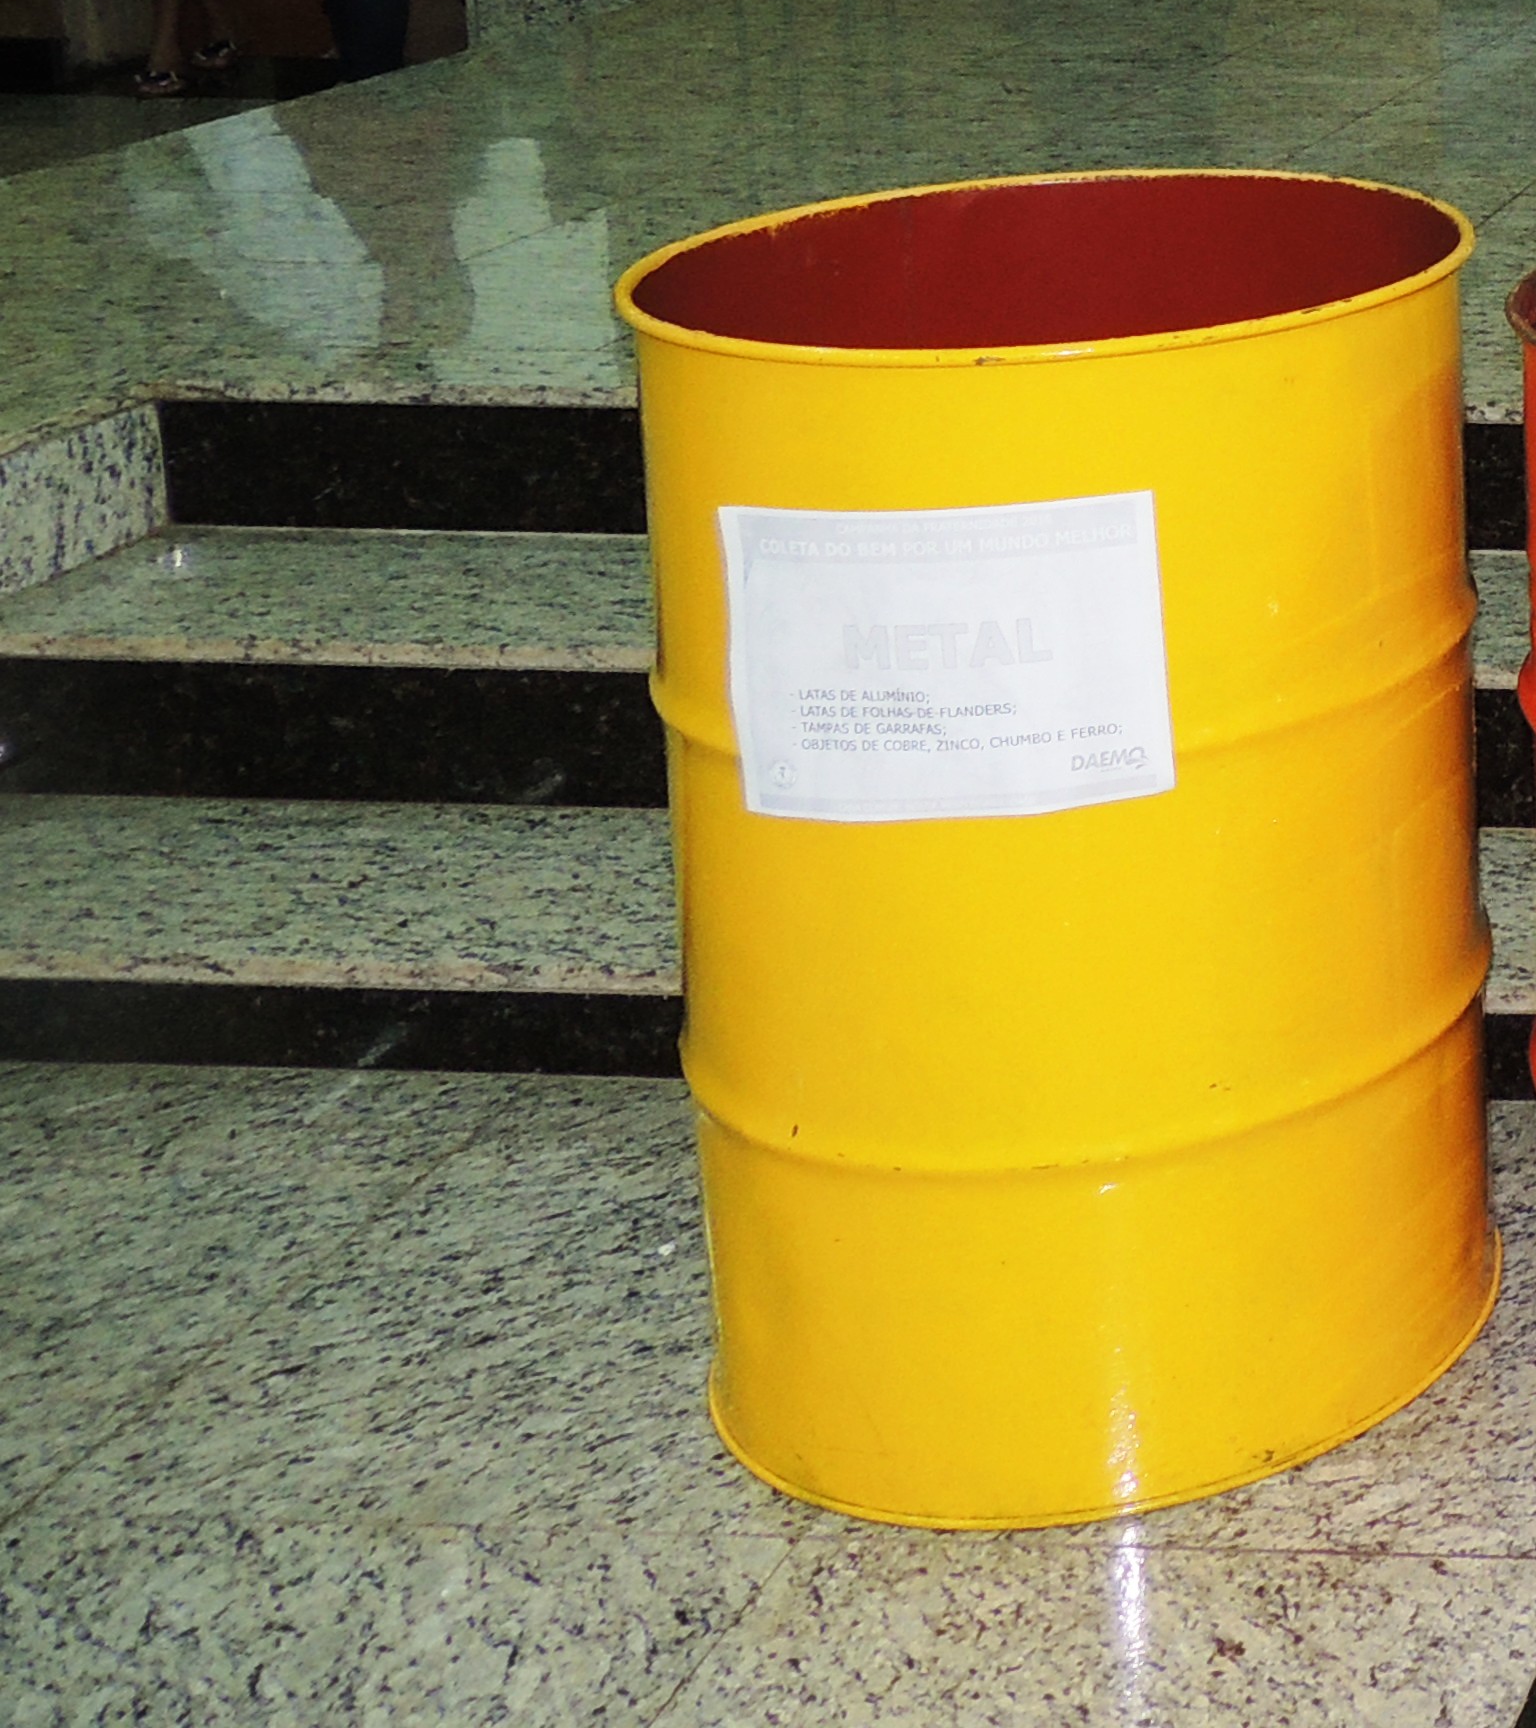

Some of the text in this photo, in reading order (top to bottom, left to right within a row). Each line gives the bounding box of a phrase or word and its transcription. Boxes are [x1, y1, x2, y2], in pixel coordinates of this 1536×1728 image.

[759, 524, 1135, 557] COLETA DO BEM POR UM MUNDO MELHOR
[842, 617, 1053, 671] METAL
[798, 687, 930, 704] LATAS DE ALUMÍNIO;
[800, 705, 836, 719] LATAS
[840, 705, 858, 718] DE
[800, 721, 947, 736] TAMPAS DE GARRAFAS;
[801, 723, 1123, 754] OBJETOS DE COBRE, ZINCO, CHUMBO E FERRO;
